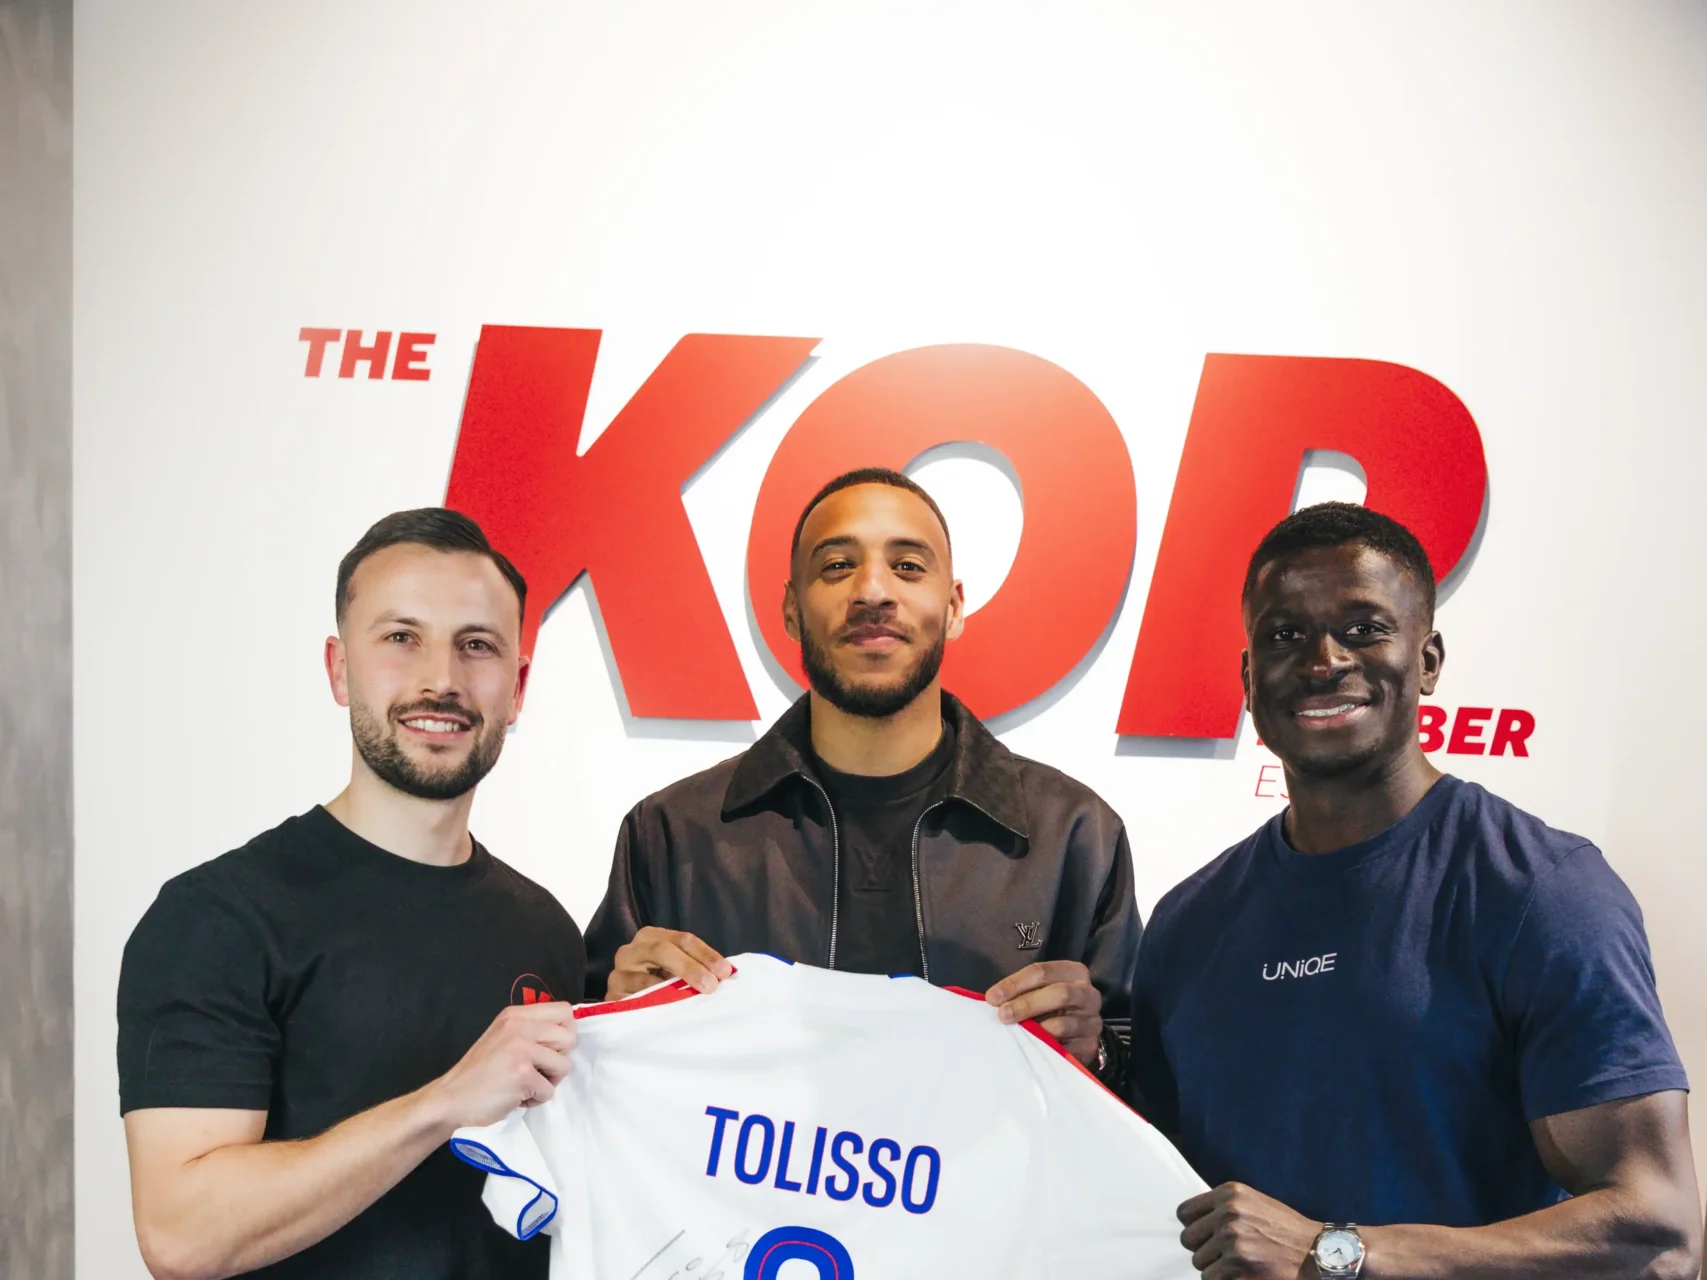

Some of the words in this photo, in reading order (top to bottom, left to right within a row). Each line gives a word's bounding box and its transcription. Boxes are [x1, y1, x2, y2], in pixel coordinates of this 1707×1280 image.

[301, 328, 437, 381] THE
[444, 324, 1489, 740] KOP
[704, 1105, 942, 1215] TOLISSO
